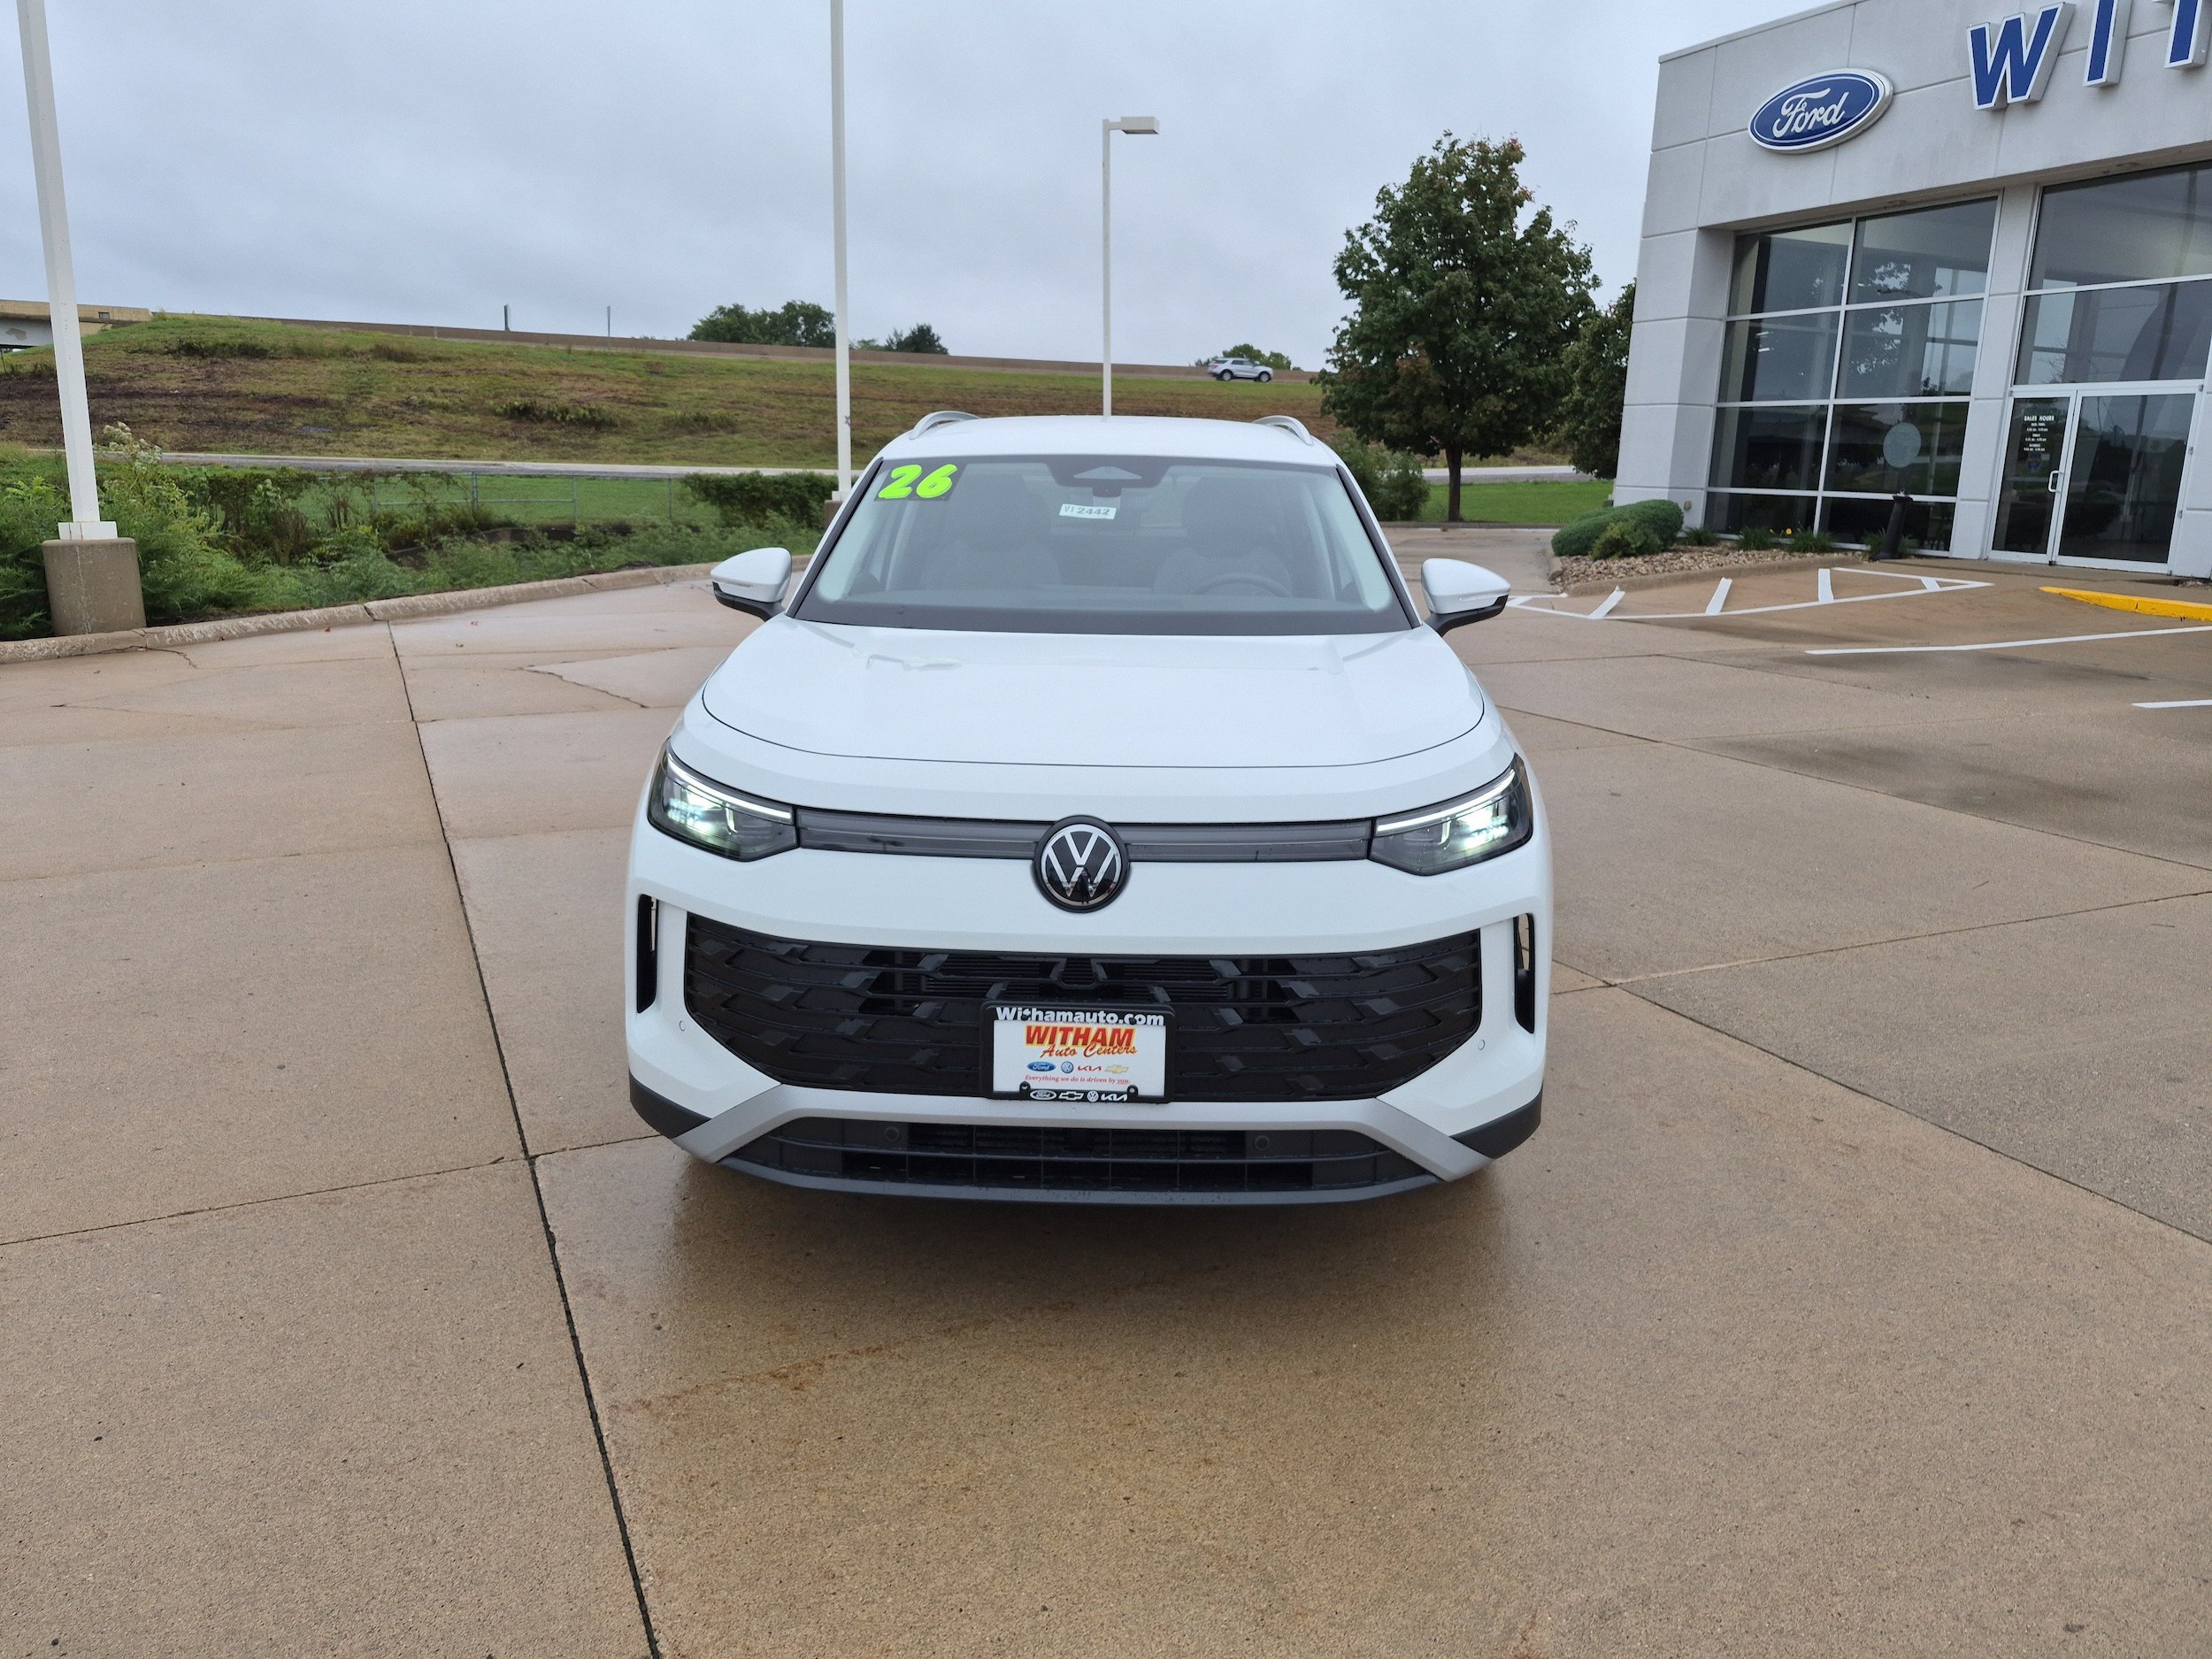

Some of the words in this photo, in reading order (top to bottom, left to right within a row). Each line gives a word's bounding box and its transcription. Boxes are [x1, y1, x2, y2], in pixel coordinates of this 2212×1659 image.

[1772, 87, 1850, 138] Ford
[878, 464, 958, 499] 26
[995, 1006, 1164, 1026] Withamauto.com
[1025, 1025, 1136, 1047] WITHAM
[1040, 1044, 1078, 1058] Auto
[1083, 1042, 1138, 1058] Centers
